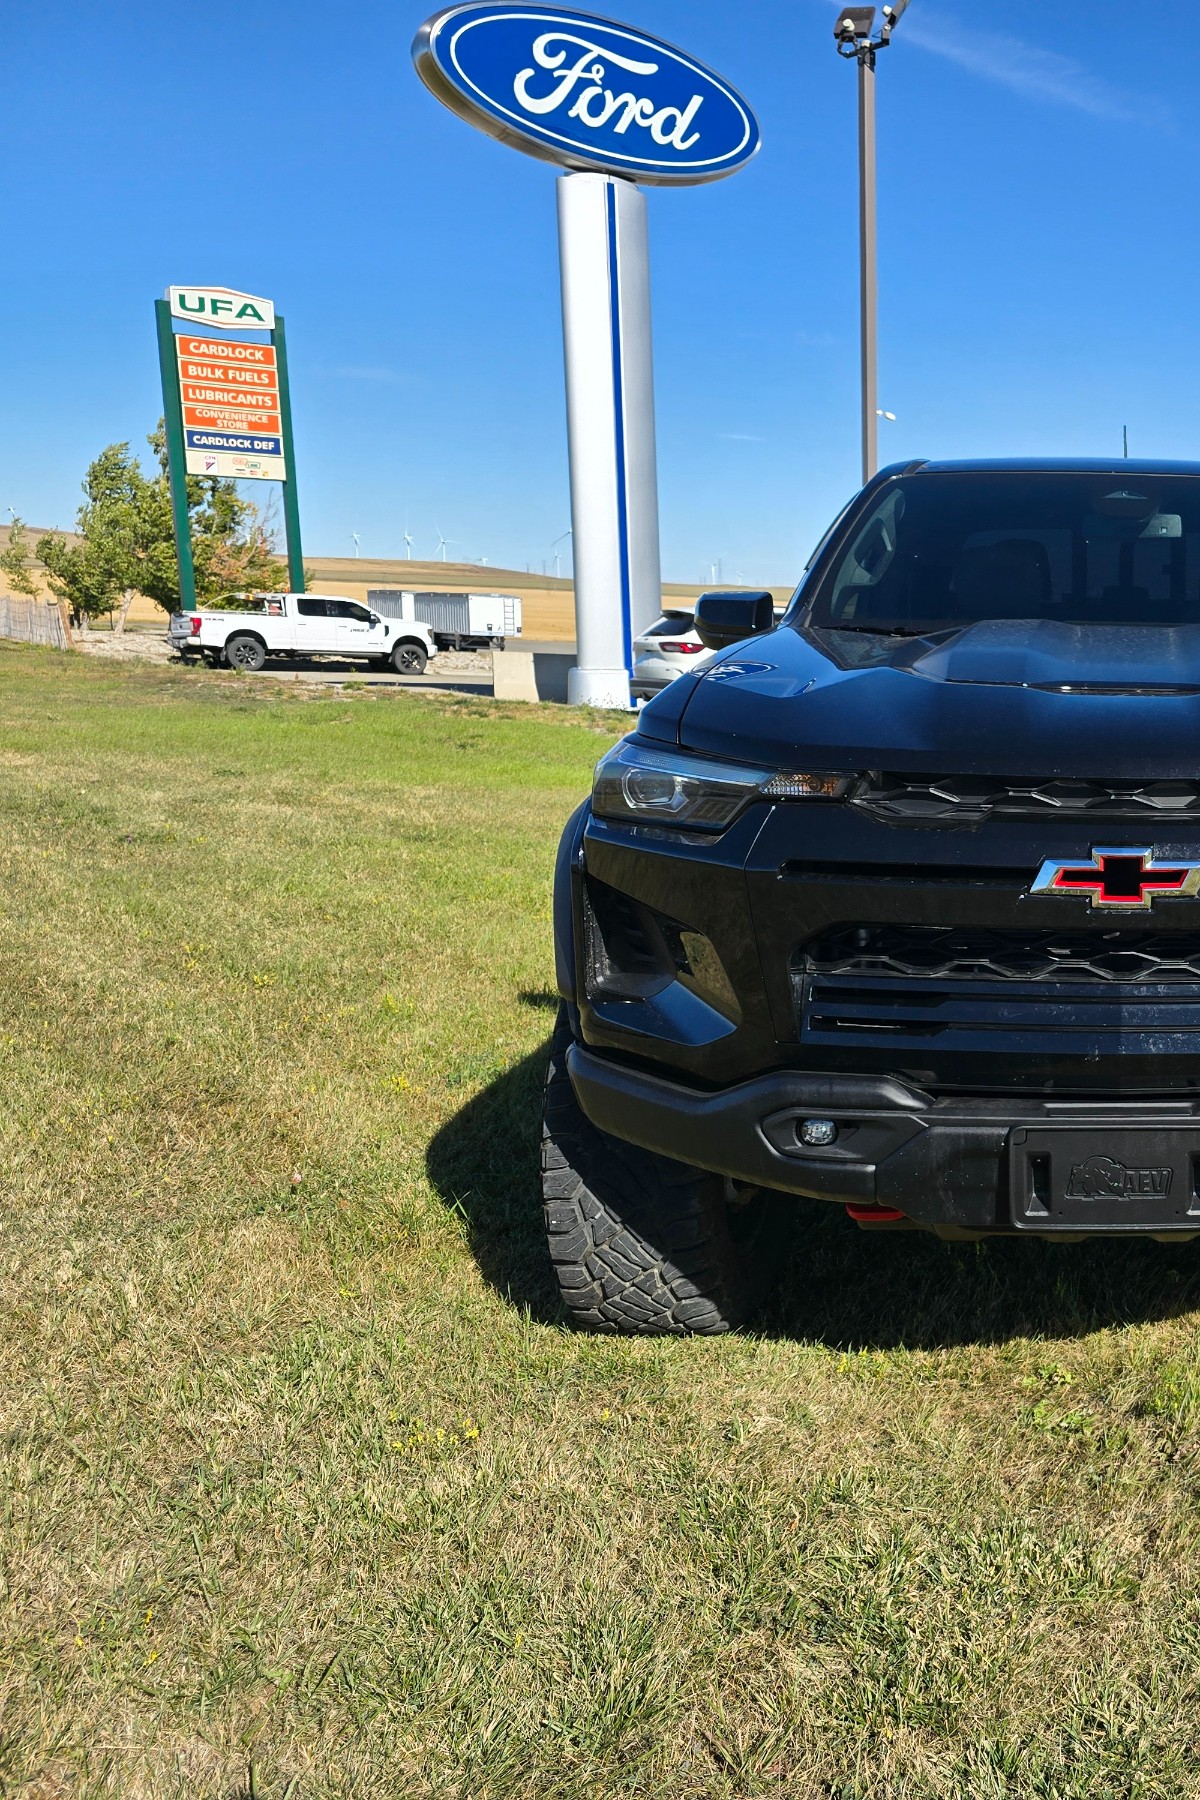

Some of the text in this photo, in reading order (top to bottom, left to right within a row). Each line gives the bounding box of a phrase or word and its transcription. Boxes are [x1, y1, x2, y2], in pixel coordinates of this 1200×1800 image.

[513, 32, 705, 151] Ford
[178, 293, 266, 322] UFA
[189, 341, 265, 361] CARDLOCK
[187, 364, 270, 384] BULK FUELS
[188, 387, 273, 407] LUBRICANTS
[195, 408, 269, 424] CONVENIENCE
[216, 419, 249, 430] STORE
[193, 435, 275, 451] CARDLOCK DEF
[1123, 1169, 1169, 1194] AEV
